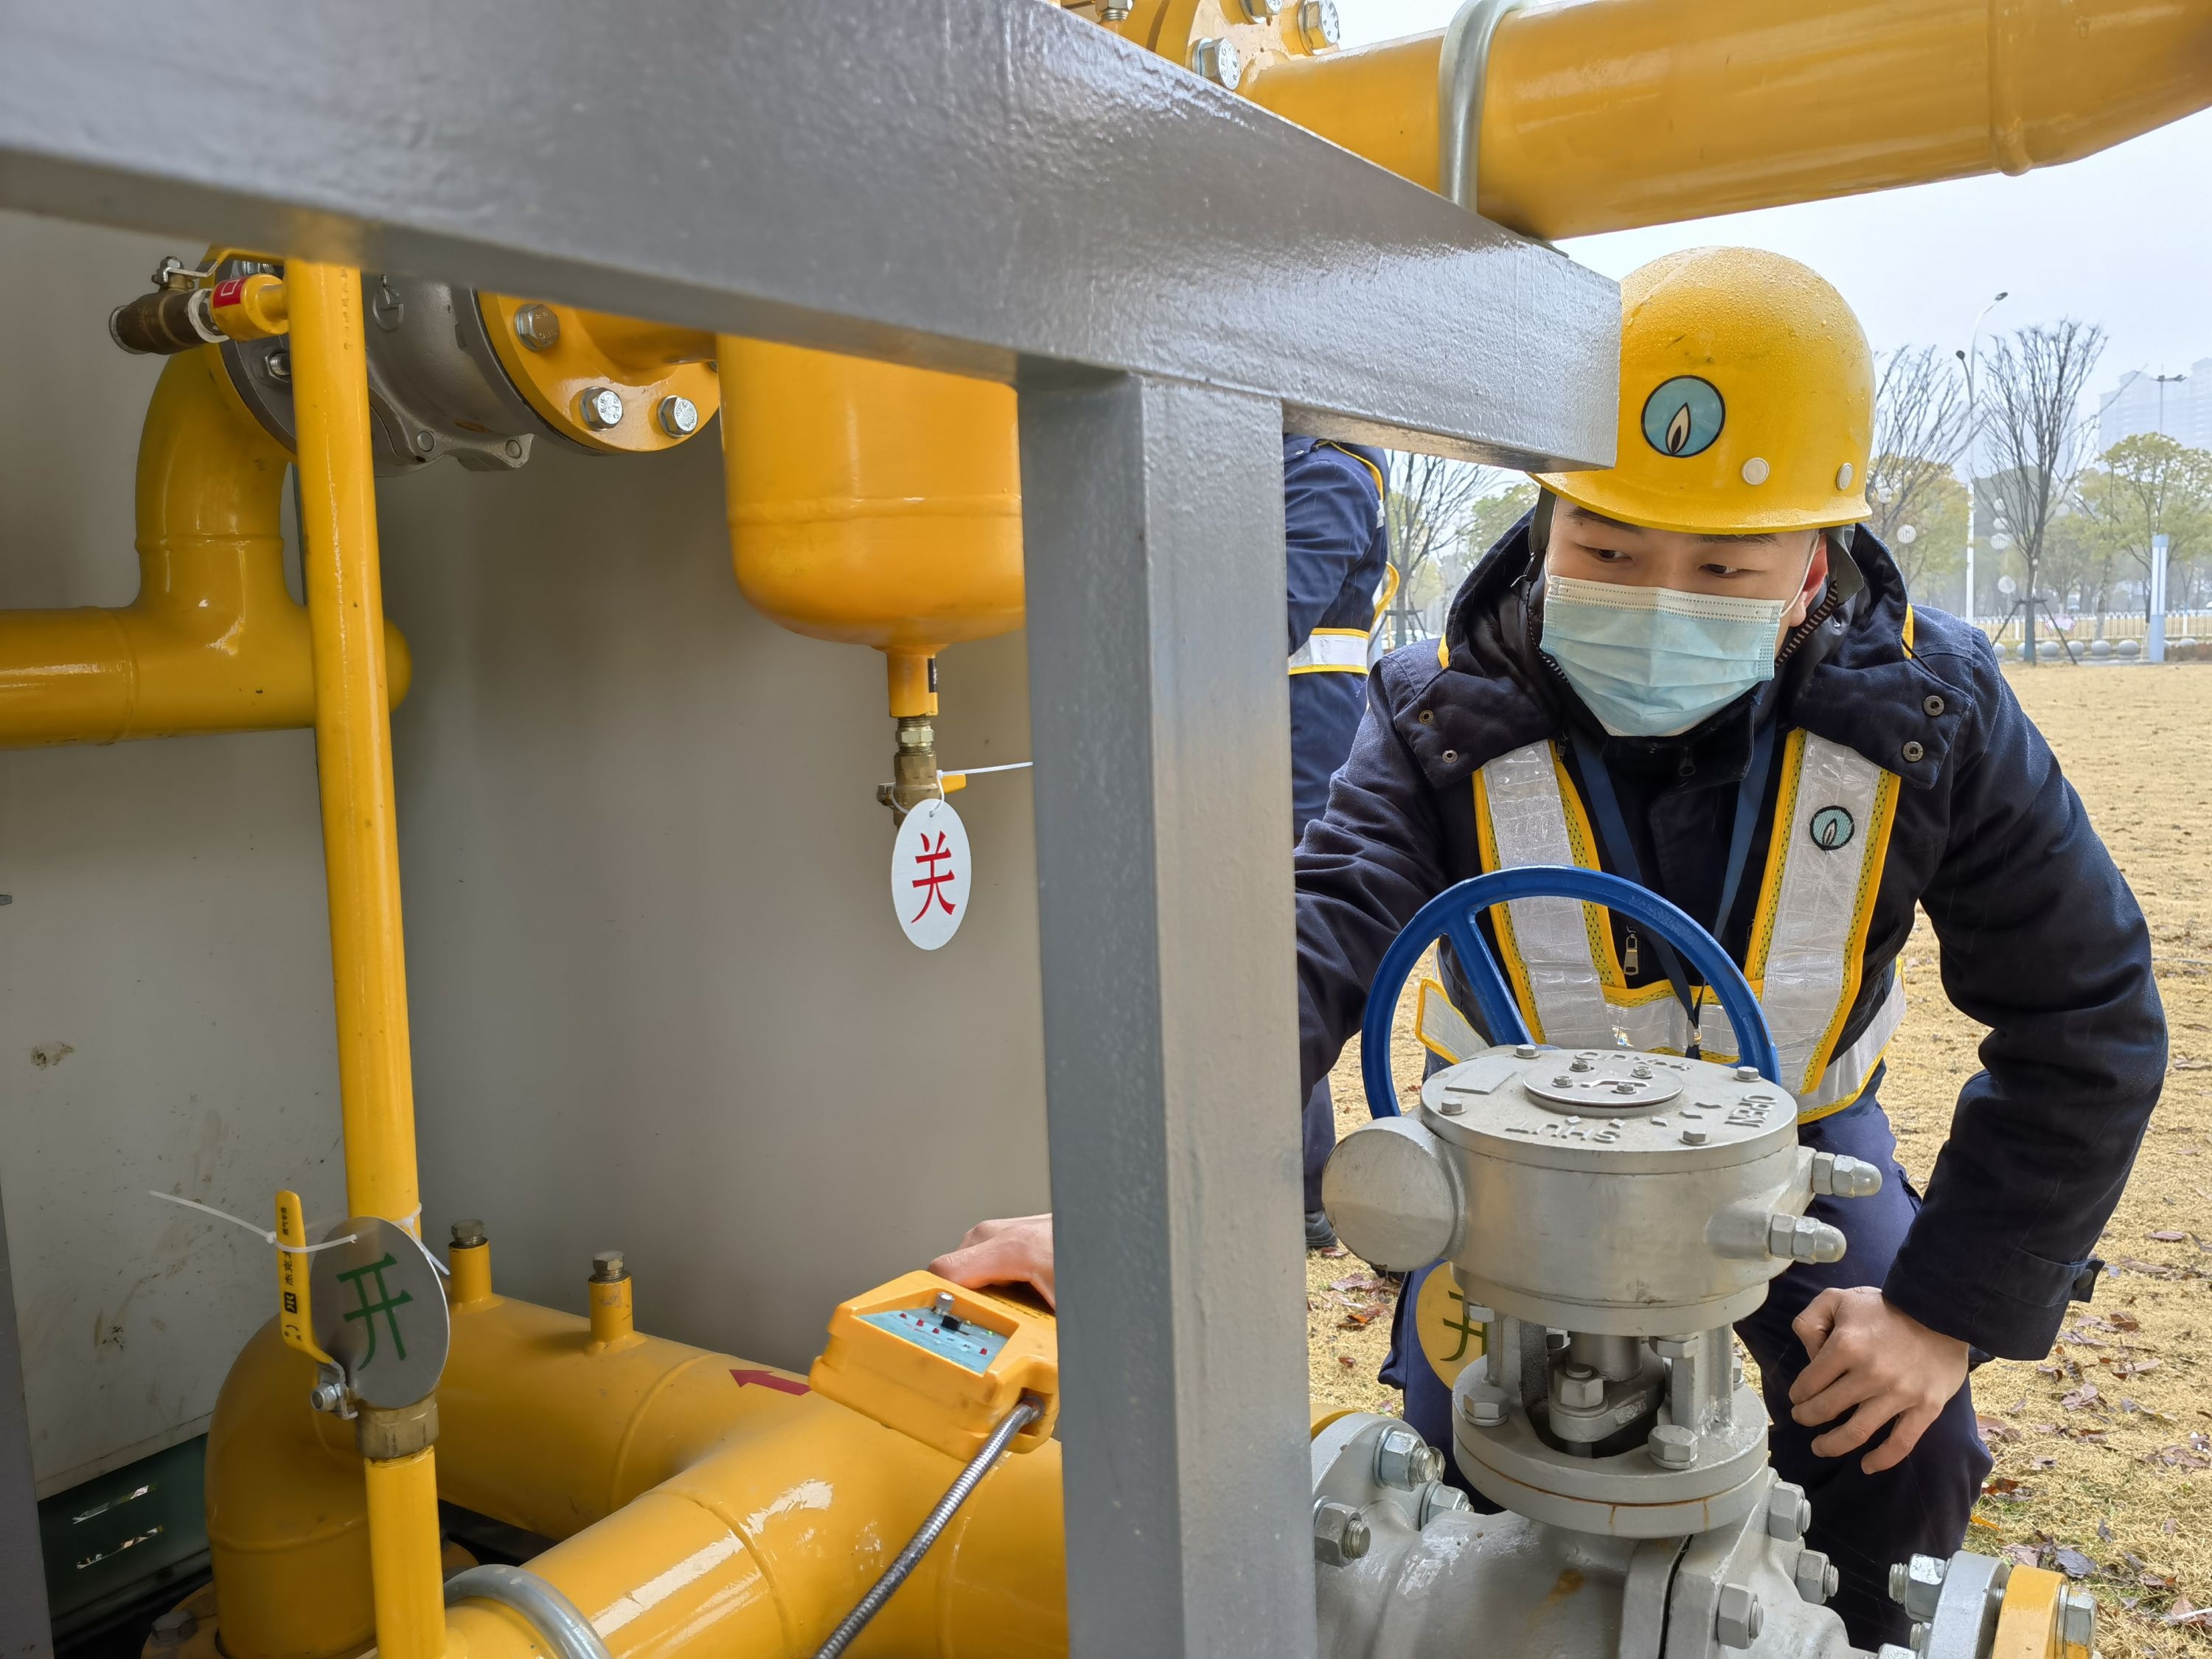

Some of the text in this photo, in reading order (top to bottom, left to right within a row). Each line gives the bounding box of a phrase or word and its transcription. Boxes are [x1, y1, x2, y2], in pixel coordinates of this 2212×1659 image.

[911, 830, 957, 924] 关
[1503, 1121, 1621, 1144] SHUT
[1723, 1093, 1778, 1128] OPEN
[335, 1252, 414, 1371] 开
